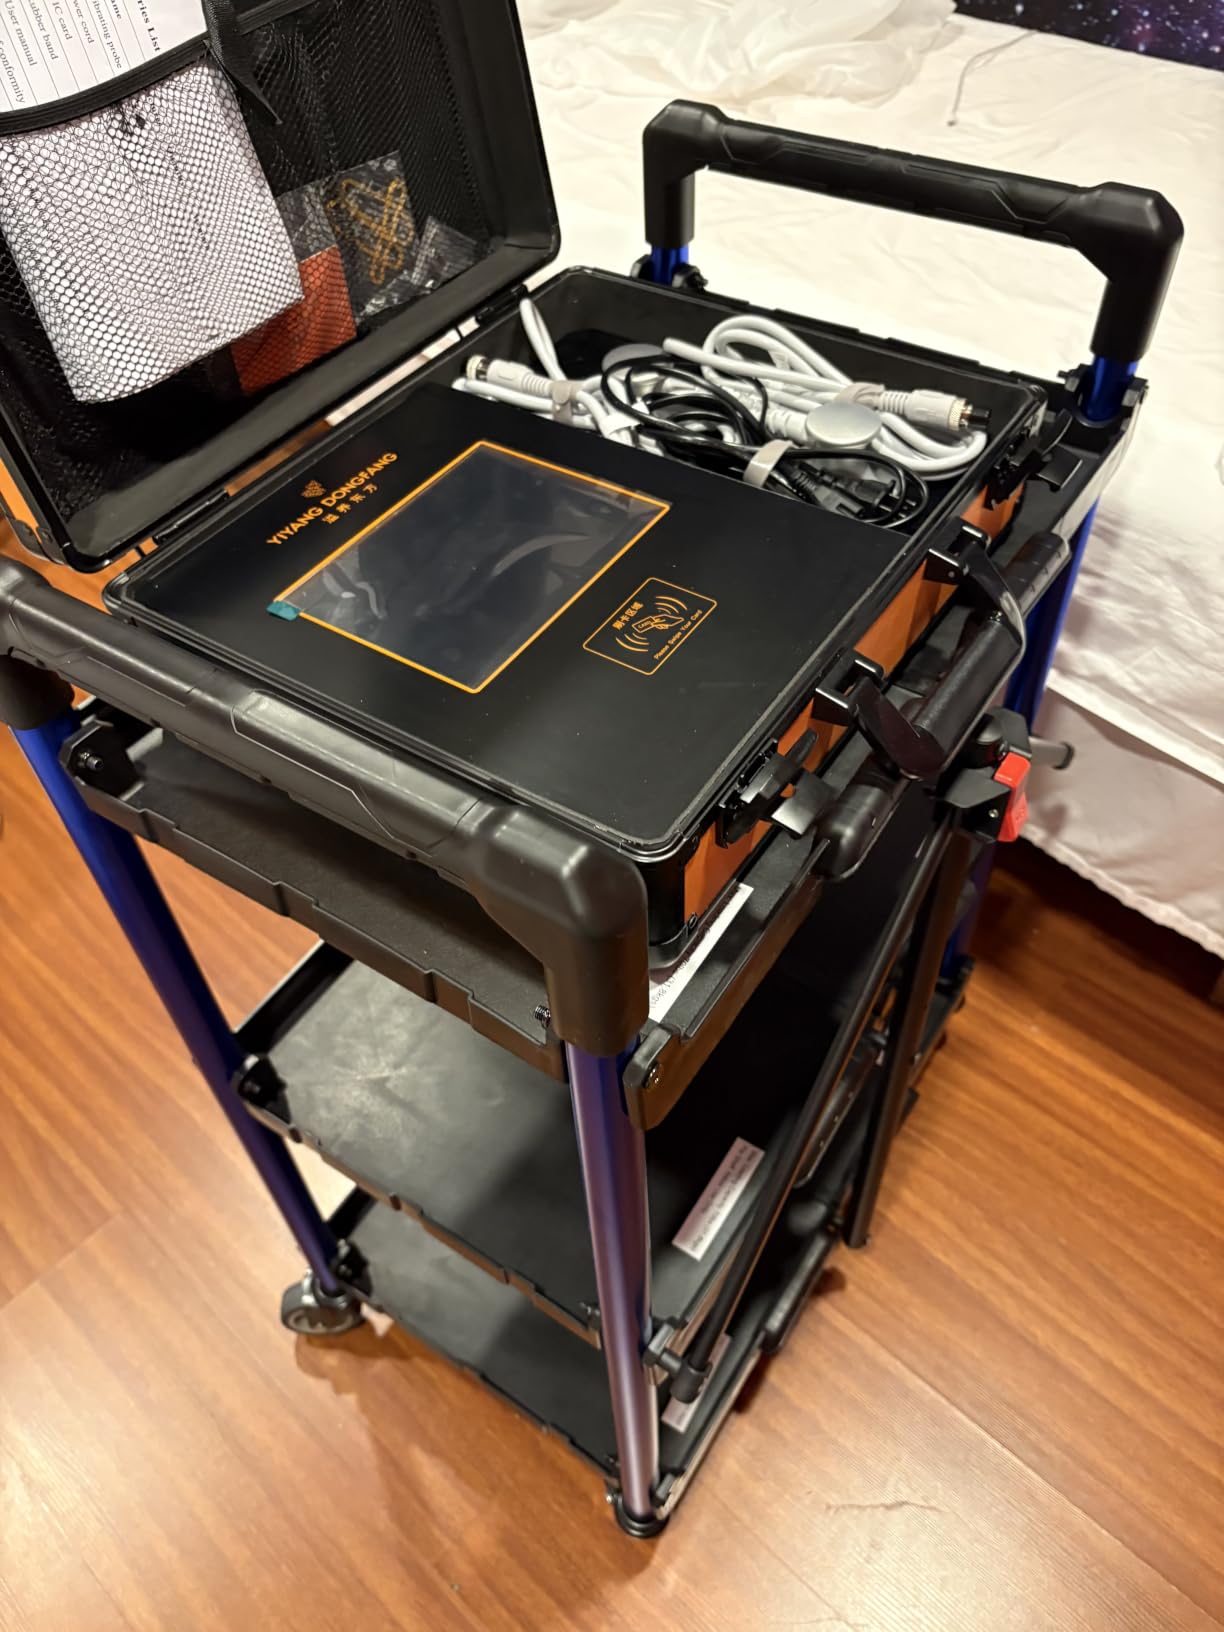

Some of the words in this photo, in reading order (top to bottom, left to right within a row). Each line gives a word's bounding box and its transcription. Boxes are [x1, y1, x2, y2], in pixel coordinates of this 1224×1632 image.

[5, 0, 20, 25] User
[16, 28, 38, 66] manual
[58, 18, 73, 40] card
[81, 21, 95, 43] cord
[147, 27, 161, 51] List
[42, 34, 59, 60] band
[107, 41, 122, 69] probe
[266, 506, 324, 545] YIYANG
[320, 452, 398, 507] DONGFANG
[690, 609, 703, 621] Card
